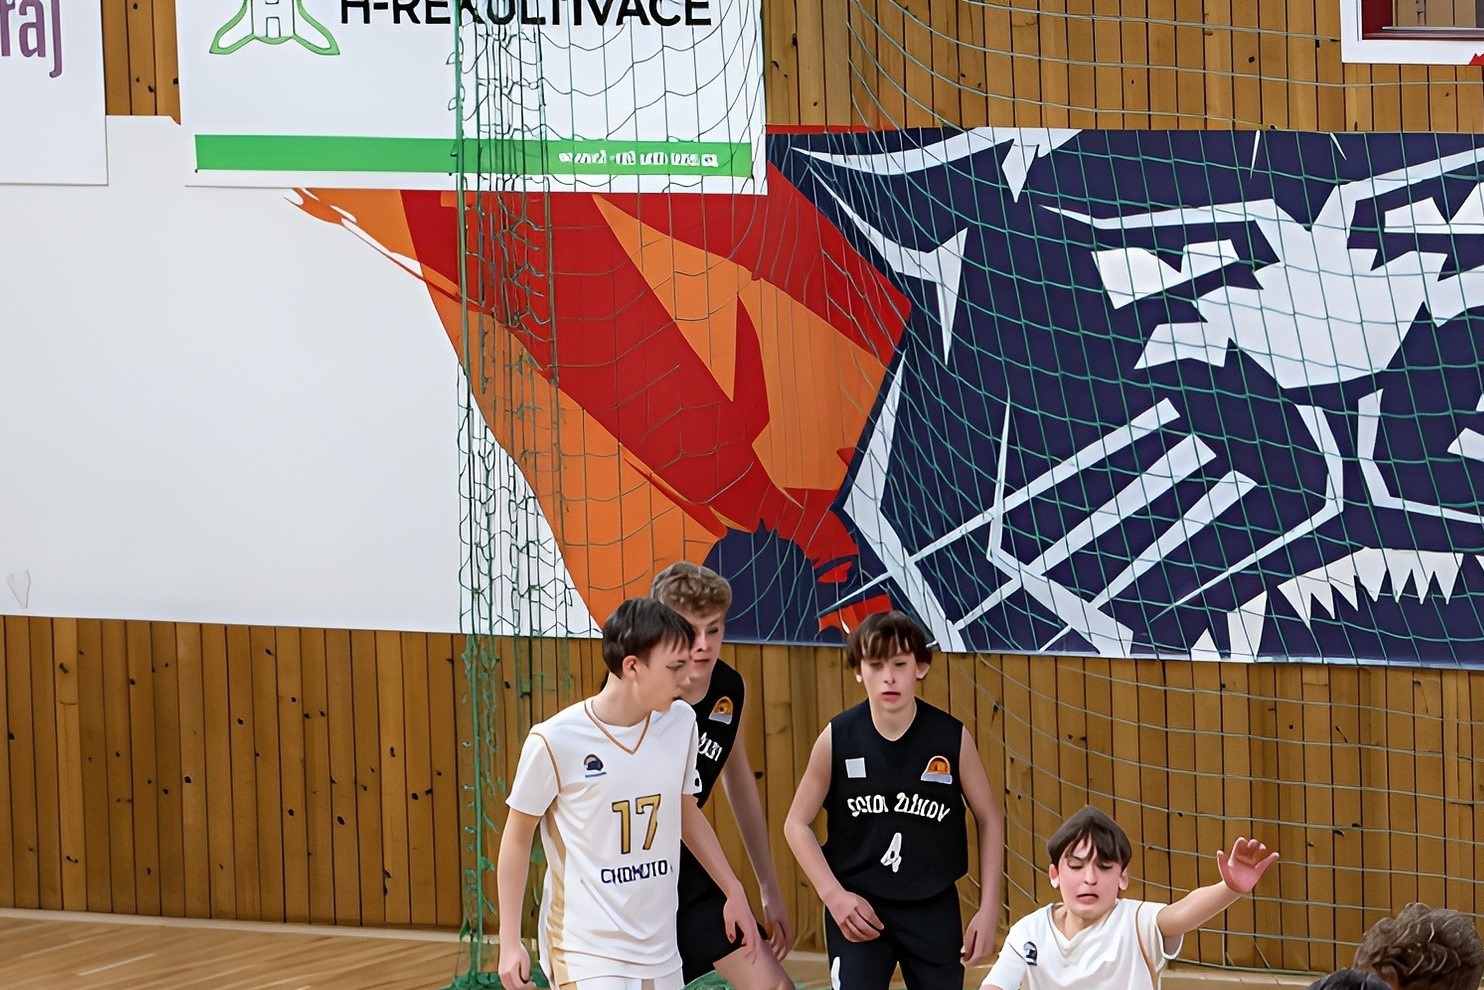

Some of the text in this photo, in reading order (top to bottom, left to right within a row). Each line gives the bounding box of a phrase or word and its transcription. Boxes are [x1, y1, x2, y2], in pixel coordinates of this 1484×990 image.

[611, 793, 661, 855] 17
[600, 859, 674, 885] CHOMUTO
[880, 832, 902, 873] 4
